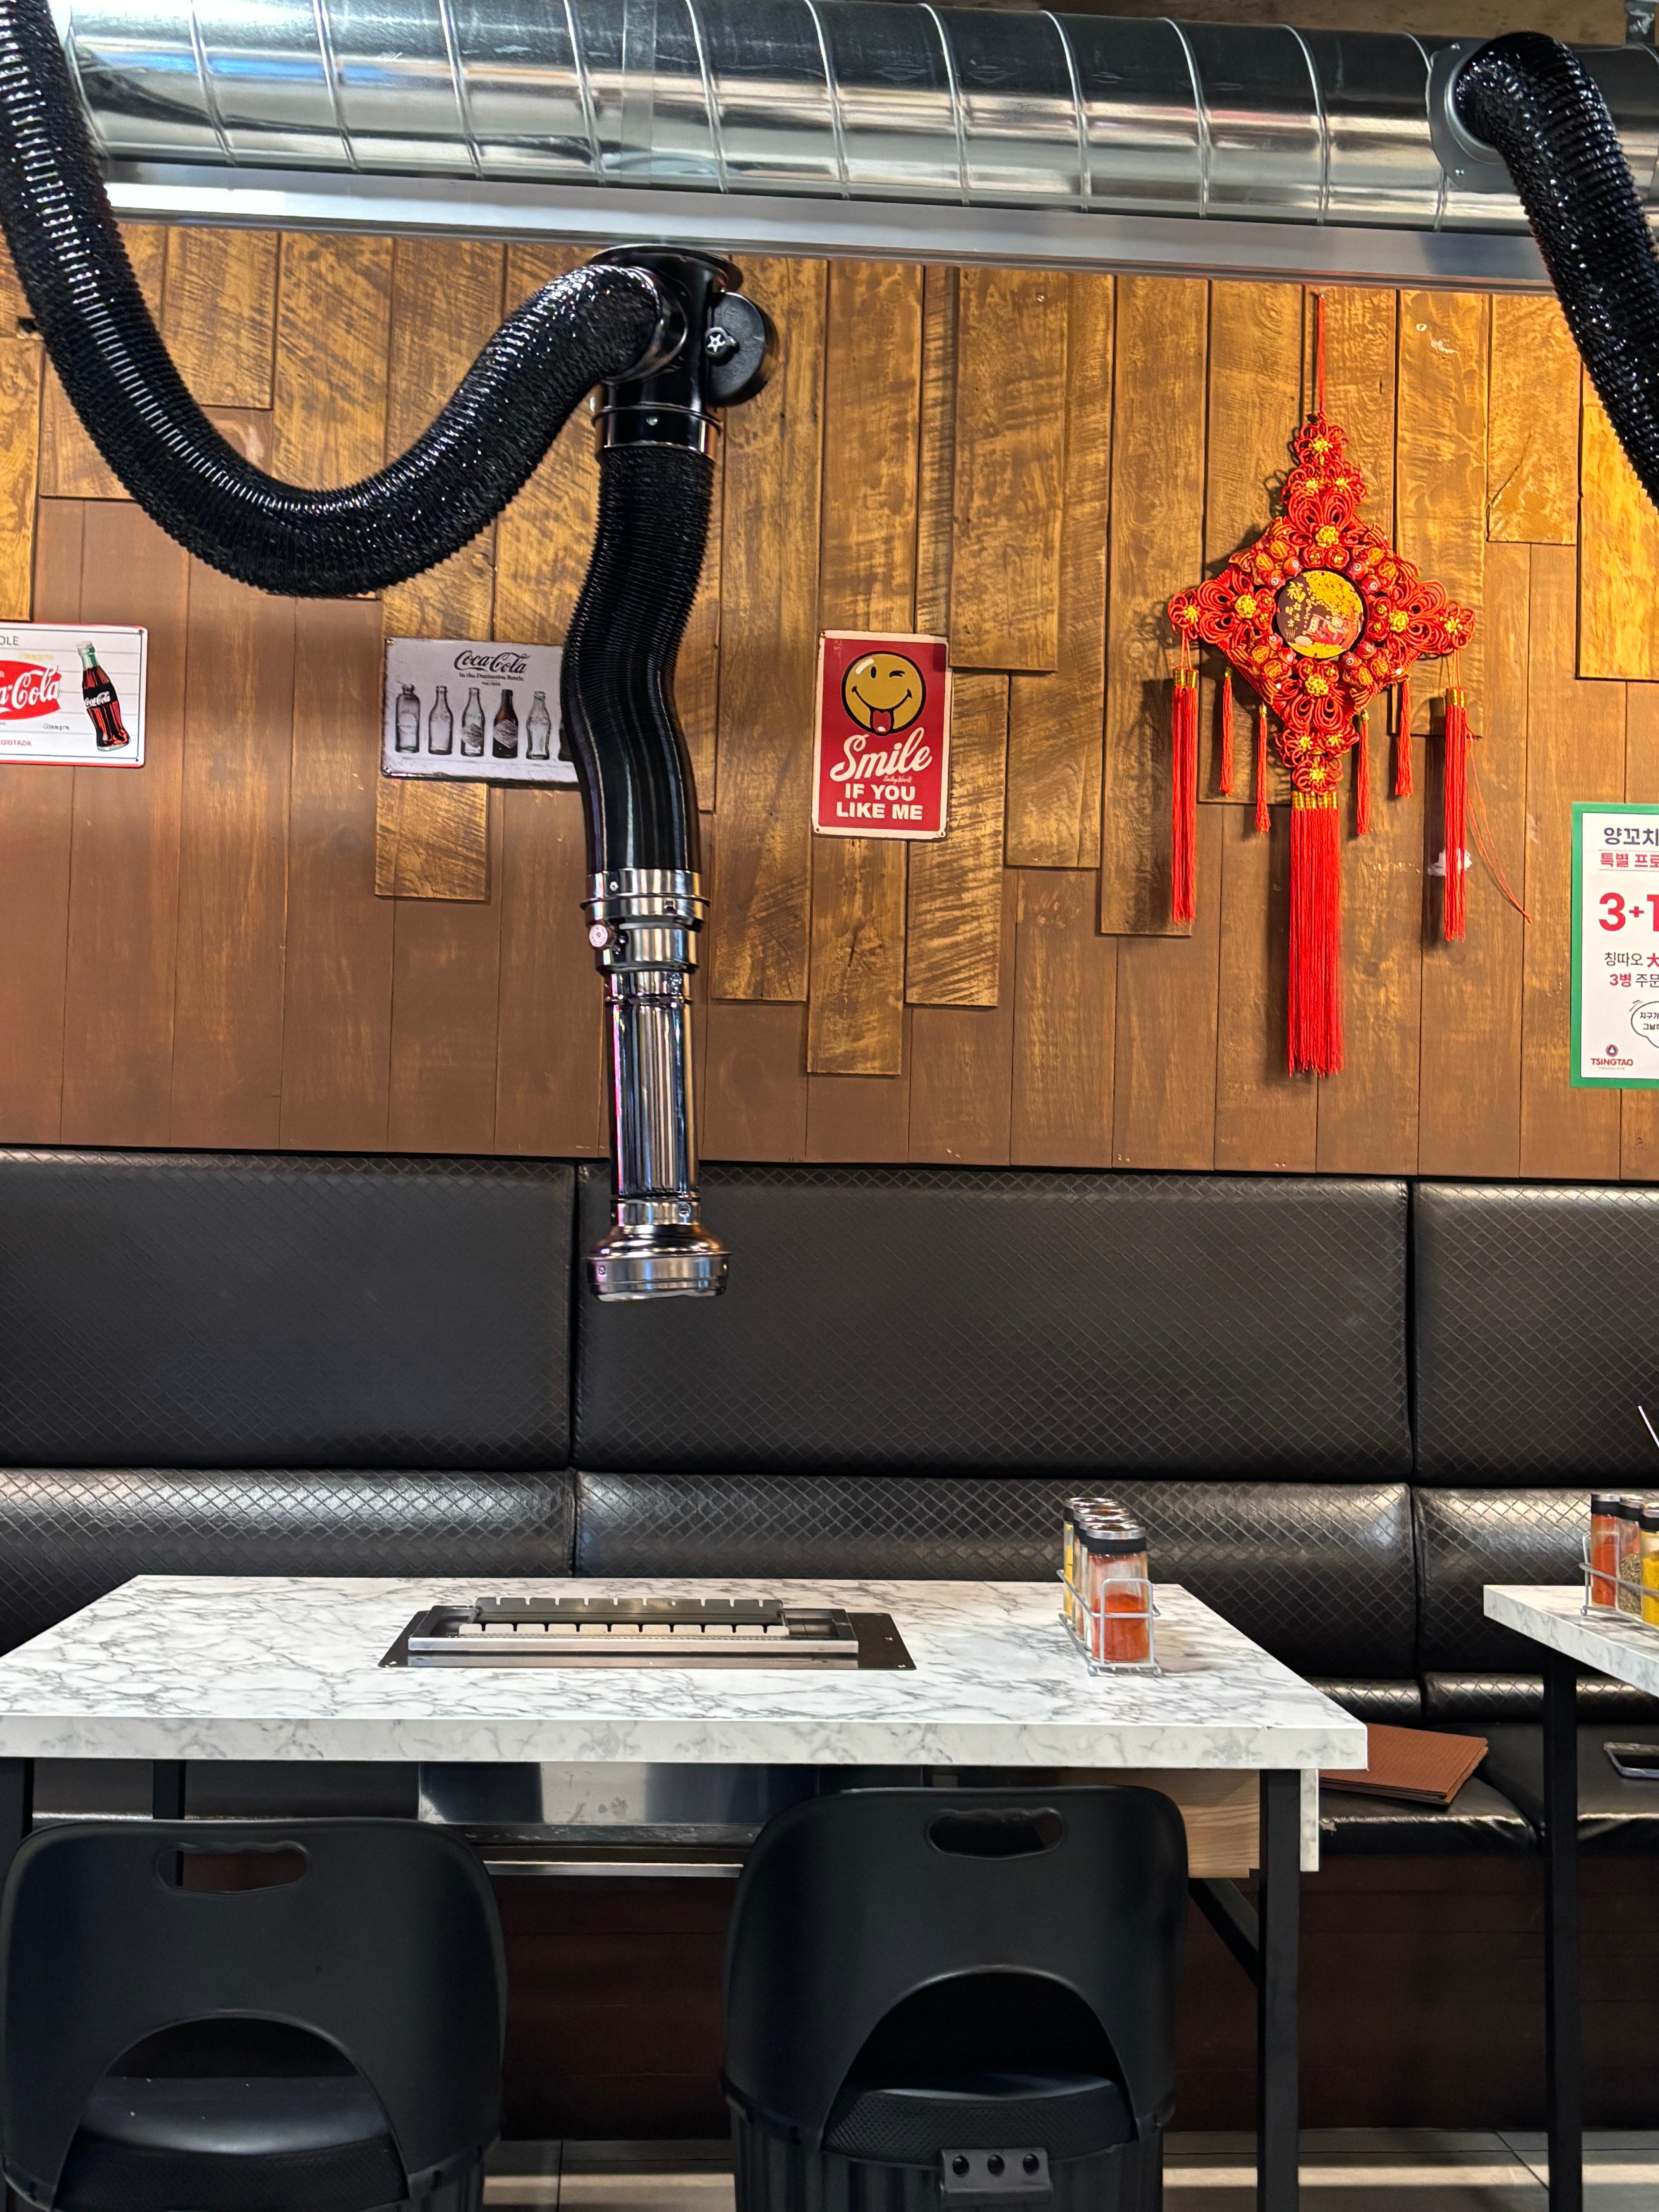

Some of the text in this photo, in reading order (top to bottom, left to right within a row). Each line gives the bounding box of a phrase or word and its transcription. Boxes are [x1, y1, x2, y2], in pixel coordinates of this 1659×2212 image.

[454, 650, 531, 673] Coca-Cola
[830, 727, 933, 781] Smile
[845, 783, 915, 801] IF YOU
[836, 802, 923, 820] LIKE ME
[1604, 827, 1659, 846] 양꼬치
[1601, 852, 1628, 867] 특별
[1604, 952, 1643, 967] 칭따오
[1610, 972, 1632, 987] 3병
[1590, 1058, 1633, 1066] TSINGTAO
